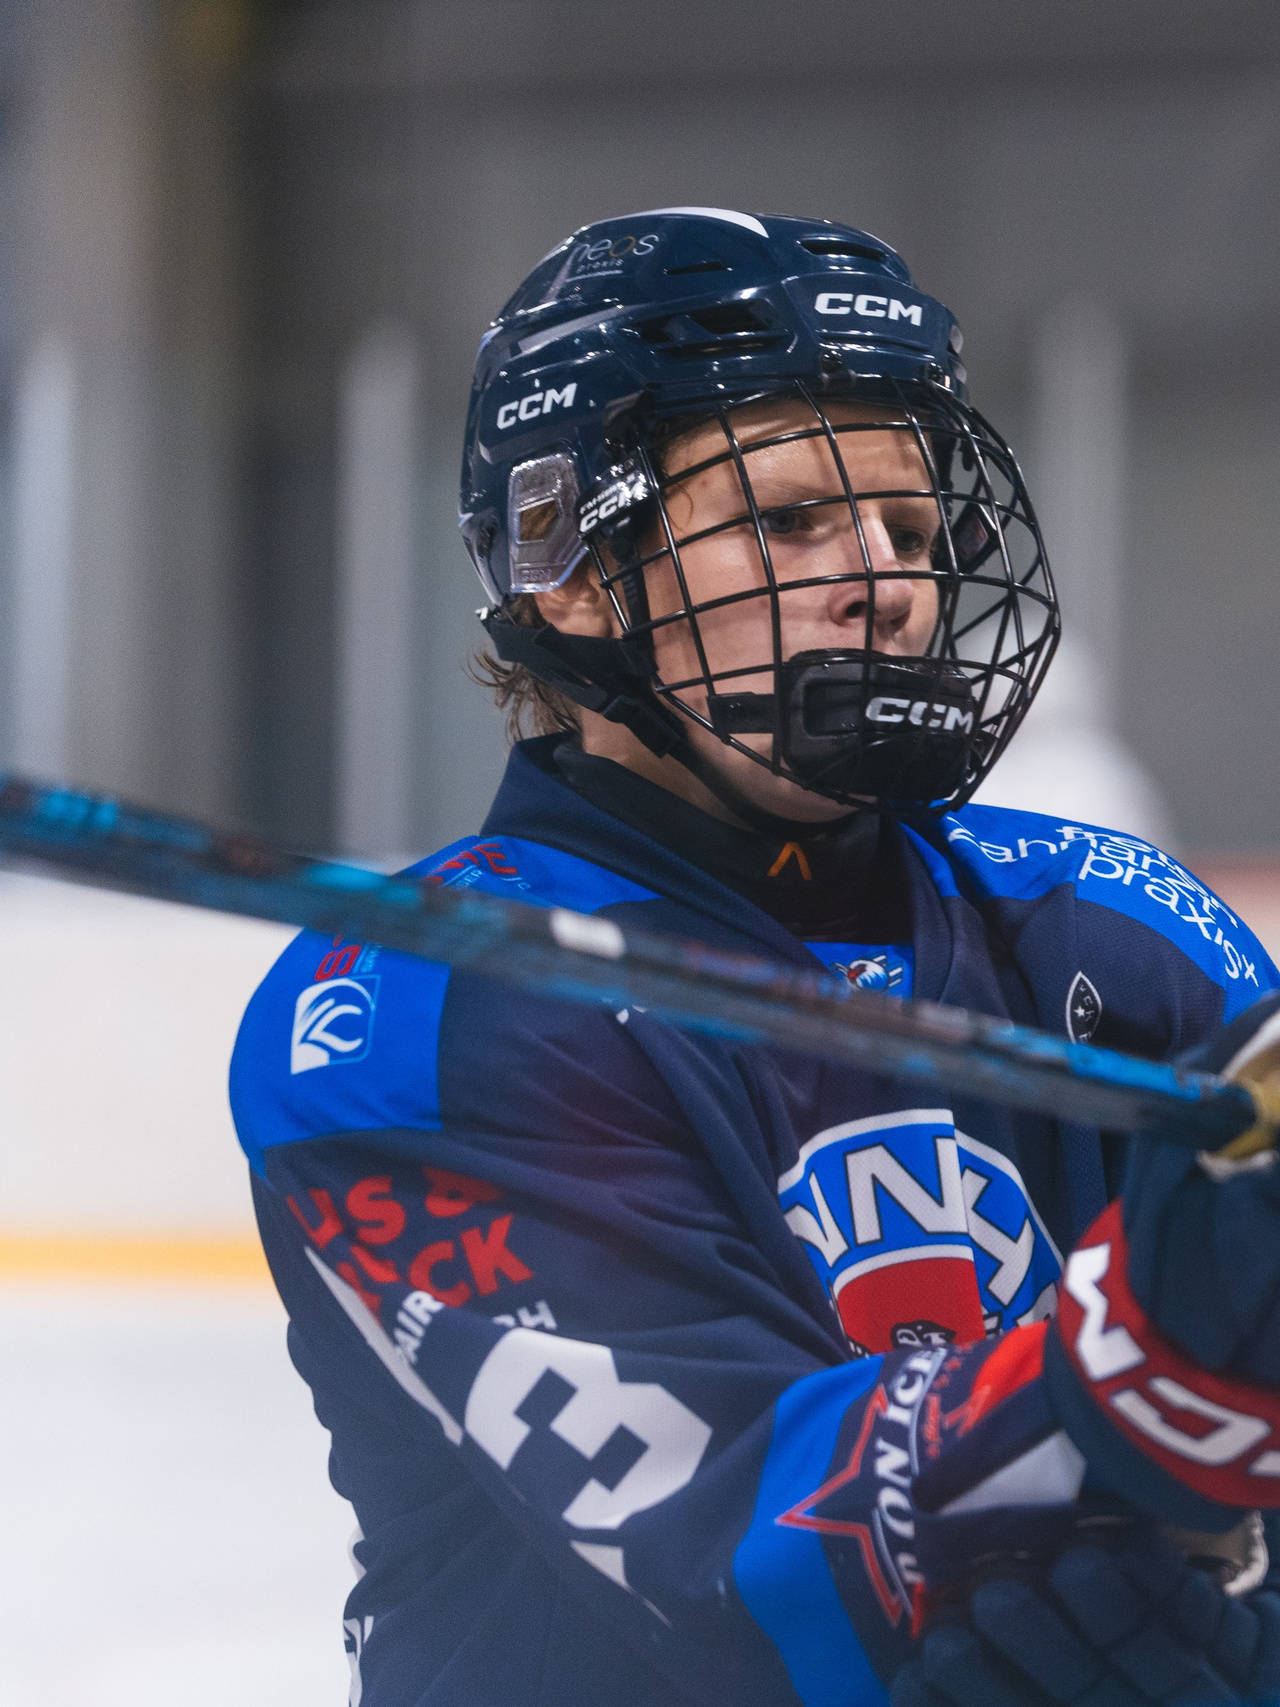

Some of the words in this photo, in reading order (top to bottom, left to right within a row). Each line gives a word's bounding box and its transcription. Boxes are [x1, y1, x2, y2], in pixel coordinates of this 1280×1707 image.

[569, 234, 660, 263] neos
[814, 292, 923, 327] CCM
[496, 382, 578, 430] CCM
[579, 474, 649, 533] CCM
[865, 696, 975, 735] CCM
